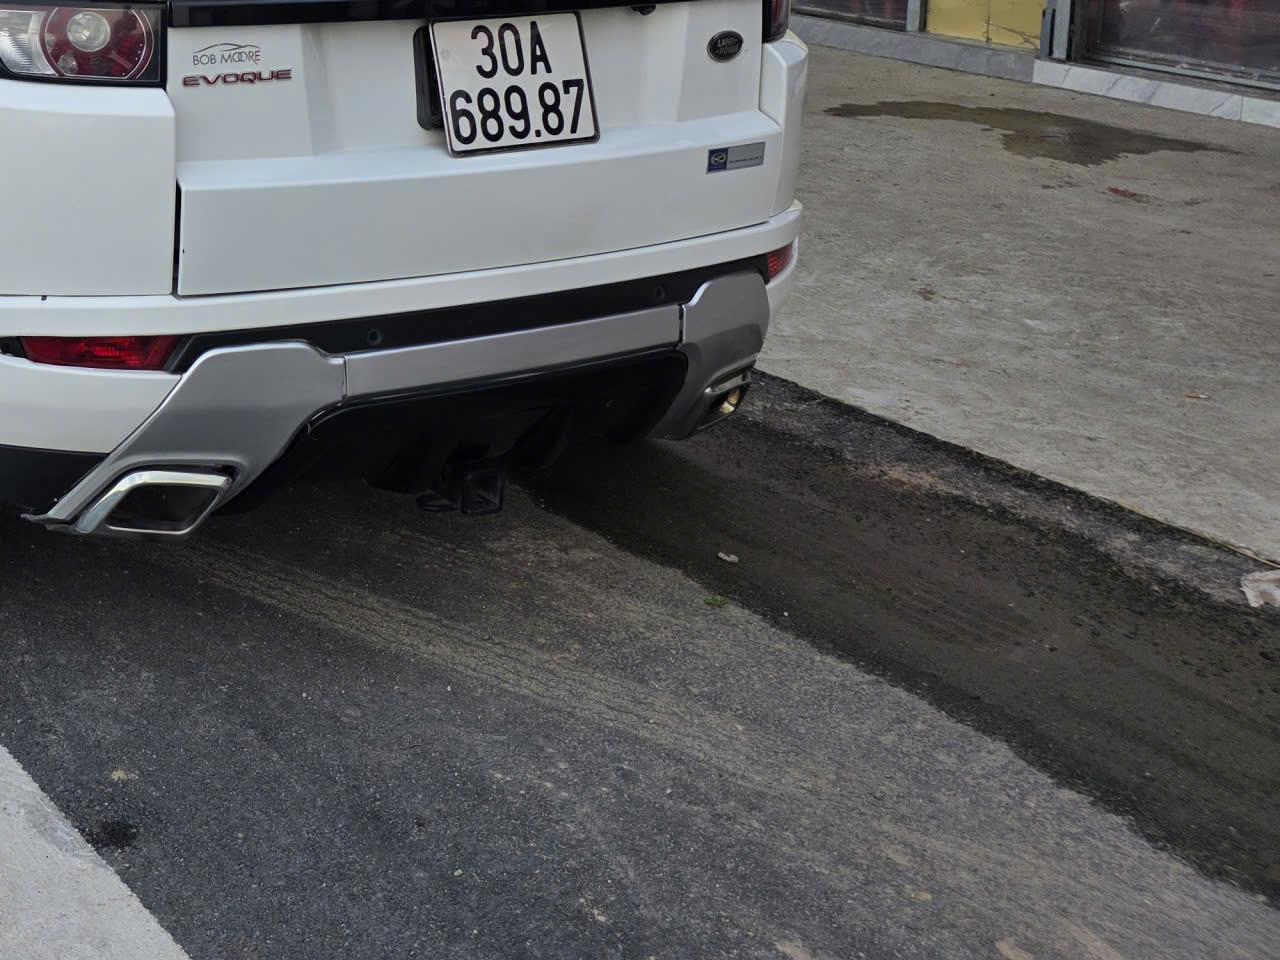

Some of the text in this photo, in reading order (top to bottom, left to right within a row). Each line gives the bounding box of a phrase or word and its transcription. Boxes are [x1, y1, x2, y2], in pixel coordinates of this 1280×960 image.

[192, 50, 261, 66] BOB MOORE
[471, 21, 553, 79] 30A
[182, 69, 292, 87] EVOQUE
[450, 78, 585, 145] 689.87
